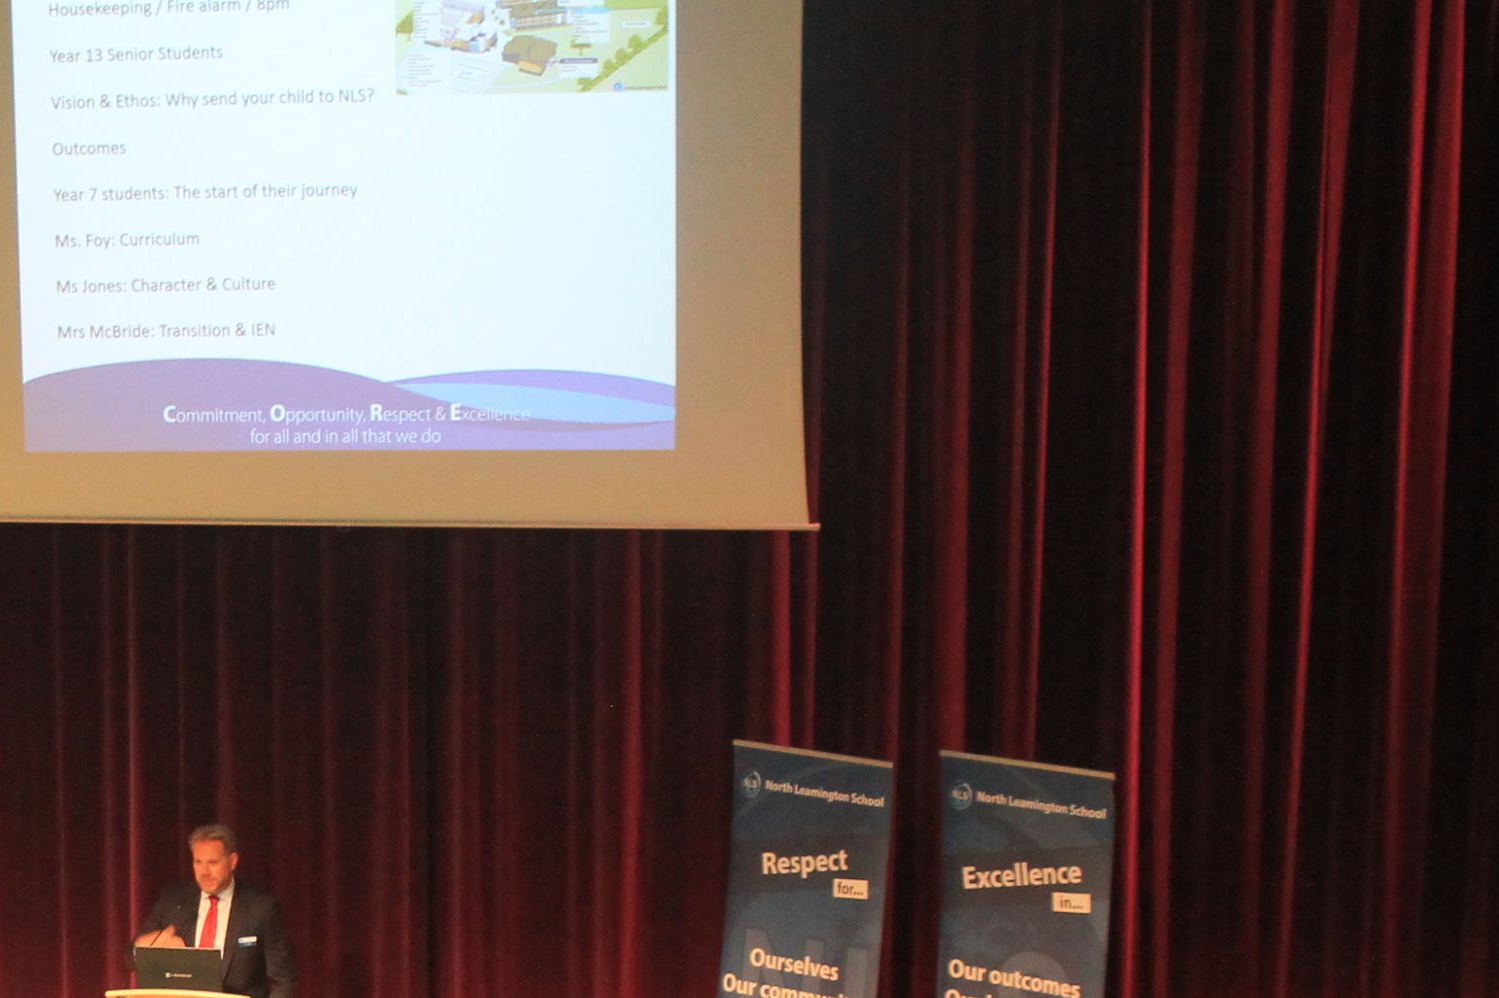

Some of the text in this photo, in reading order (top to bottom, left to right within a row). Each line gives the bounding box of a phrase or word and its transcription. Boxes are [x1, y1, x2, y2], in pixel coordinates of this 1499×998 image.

[48, 2, 152, 17] Housekeeping
[167, 0, 194, 12] Fire
[198, 0, 241, 12] alarm
[257, 0, 290, 12] 8pm
[50, 46, 223, 63] Year 13 Senior Students
[50, 88, 374, 109] Vision & Ethos: Why send your child to NLS?
[52, 142, 126, 156] Outcomes
[53, 183, 358, 202] Year 7 students: The start of their journey
[55, 232, 200, 250] Ms. Foy: Curriculum
[56, 276, 276, 293] Ms Jones: Character & Culture
[58, 322, 275, 339] Mrs McBride: Transition & IEN
[163, 402, 535, 425] Commitment, Opportunity, Respect & Excellence
[250, 428, 441, 444] for all and in all that we do
[765, 780, 884, 807] North Leamington School
[976, 791, 1107, 819] North Leamington School
[762, 851, 848, 877] Respect
[962, 863, 1082, 888] Excellence
[750, 949, 839, 980] Ourselves
[723, 973, 757, 996] Our
[948, 959, 1080, 998] Our outcomes
